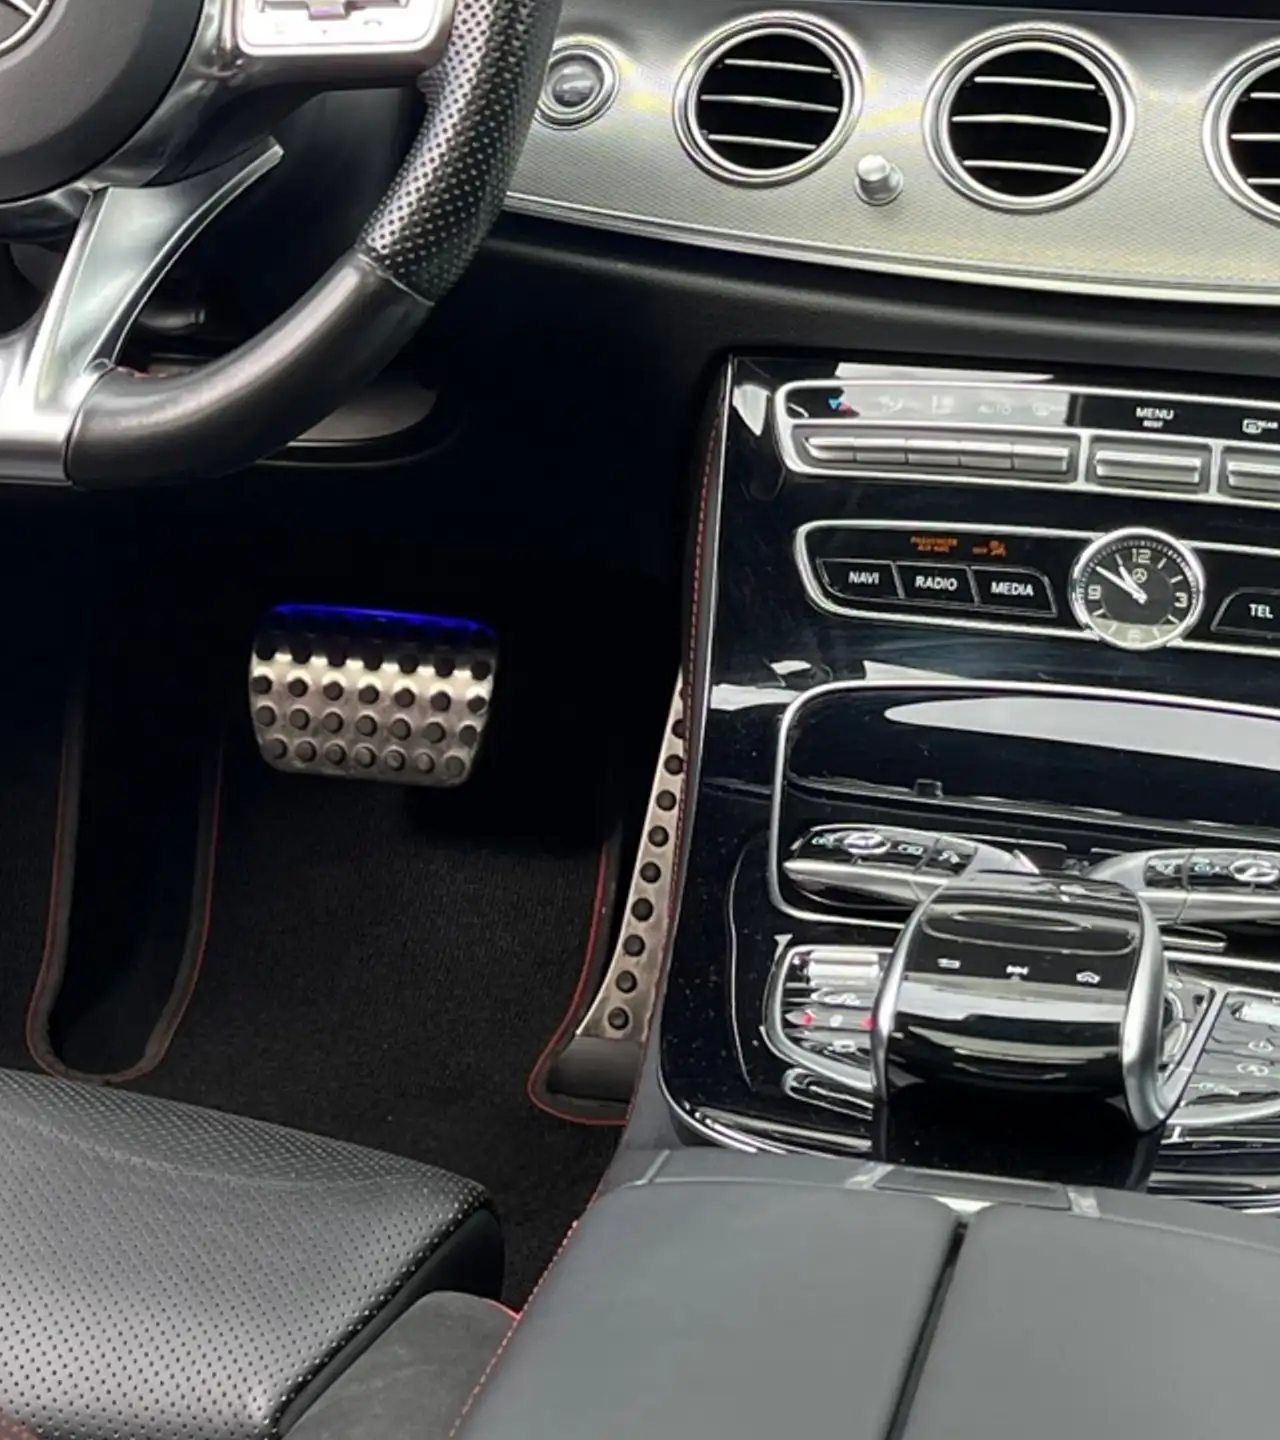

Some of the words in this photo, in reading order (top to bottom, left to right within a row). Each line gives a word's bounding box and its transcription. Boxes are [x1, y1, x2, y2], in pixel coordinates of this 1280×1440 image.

[1135, 406, 1174, 421] MENU
[1131, 548, 1151, 564] 12
[848, 571, 880, 585] NAVI
[915, 576, 958, 591] RADIO
[991, 581, 1035, 597] MEDIA
[1174, 592, 1188, 608] 3
[1249, 603, 1274, 620] TEL
